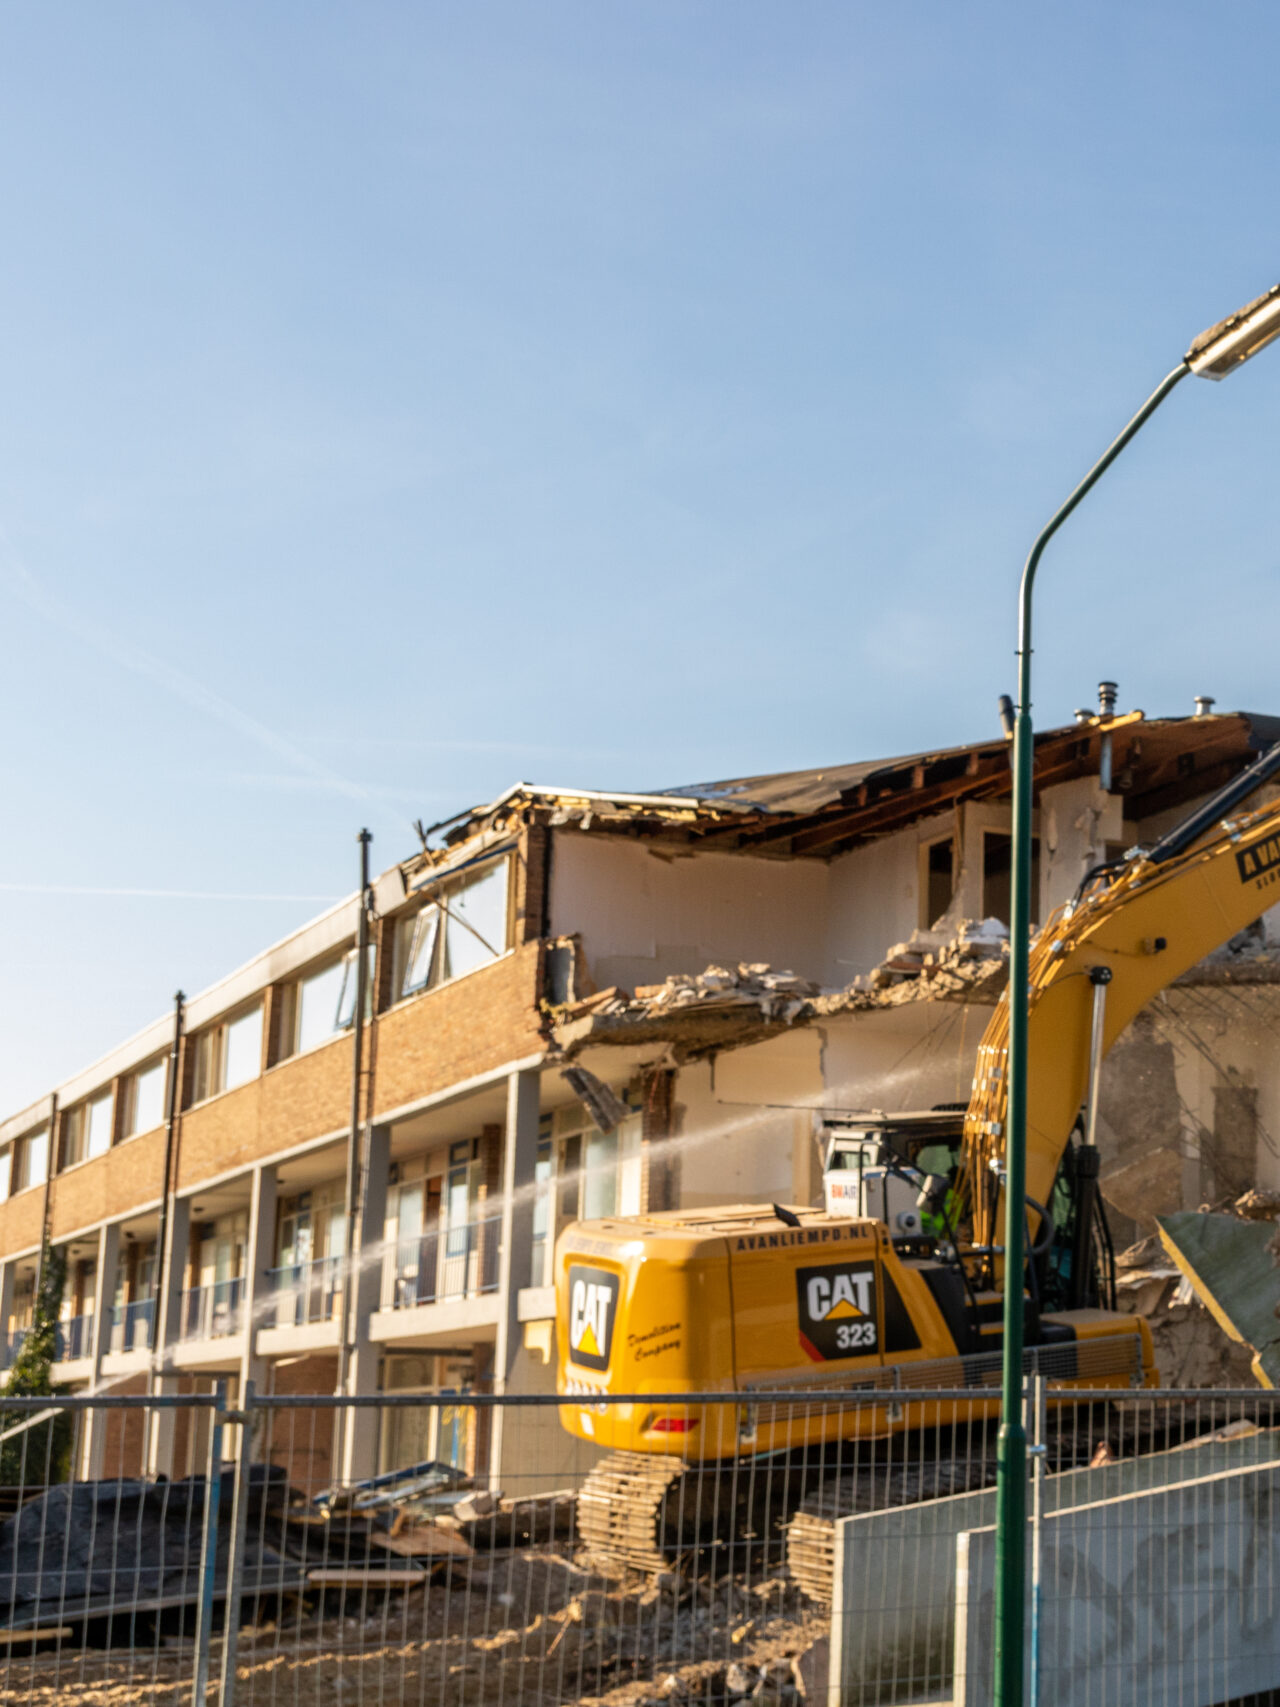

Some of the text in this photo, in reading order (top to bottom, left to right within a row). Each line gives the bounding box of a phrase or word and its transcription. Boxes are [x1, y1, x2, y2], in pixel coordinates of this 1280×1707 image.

[1243, 852, 1257, 875] A
[737, 1225, 868, 1250] AVANLIEMPD.NL
[806, 1271, 874, 1322] CAT
[571, 1279, 612, 1357] CAT
[837, 1323, 876, 1349] 323
